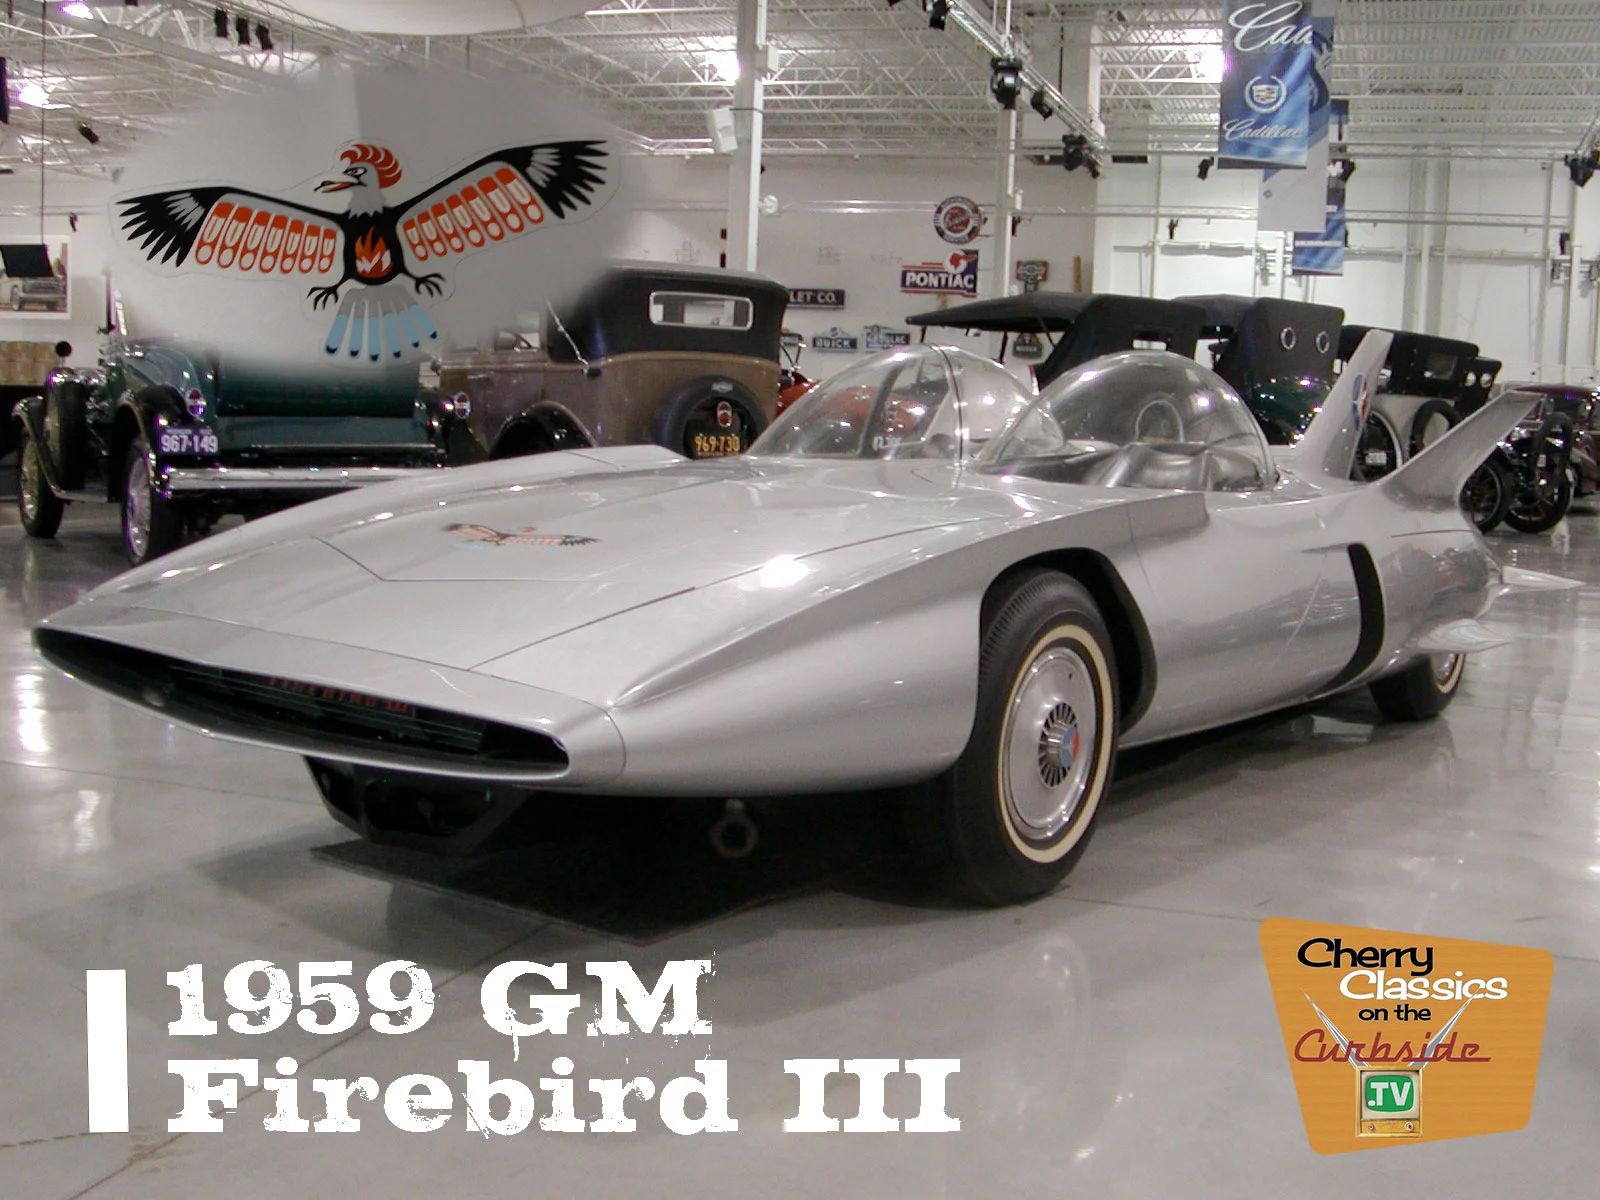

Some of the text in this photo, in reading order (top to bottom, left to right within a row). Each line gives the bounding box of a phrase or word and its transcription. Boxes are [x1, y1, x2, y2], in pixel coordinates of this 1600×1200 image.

[1222, 118, 1304, 141] Cadillac
[905, 272, 975, 288] PONTIAC
[815, 337, 850, 348] BUICK
